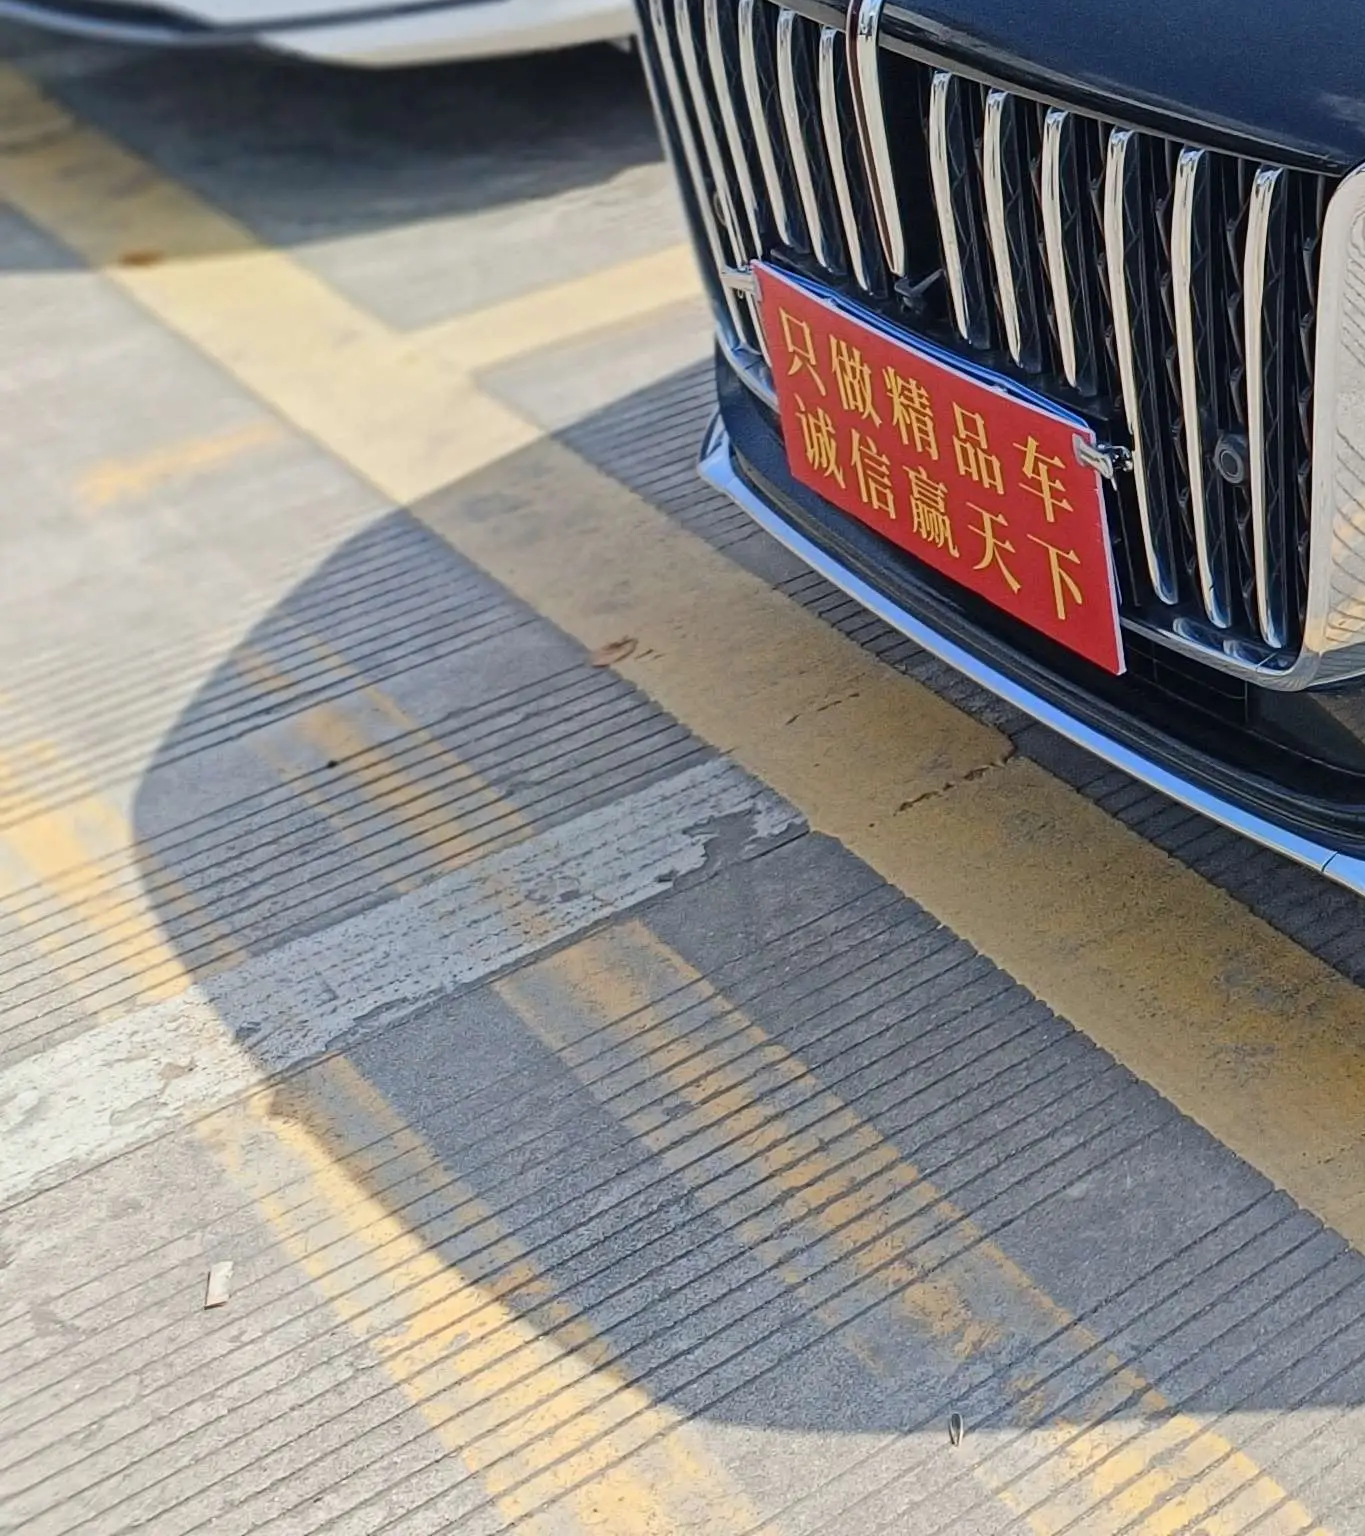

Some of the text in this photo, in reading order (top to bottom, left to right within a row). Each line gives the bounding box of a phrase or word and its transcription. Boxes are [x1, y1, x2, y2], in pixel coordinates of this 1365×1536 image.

[779, 307, 1074, 523] 只做精品车
[796, 393, 1083, 620] 诚信赢天下
